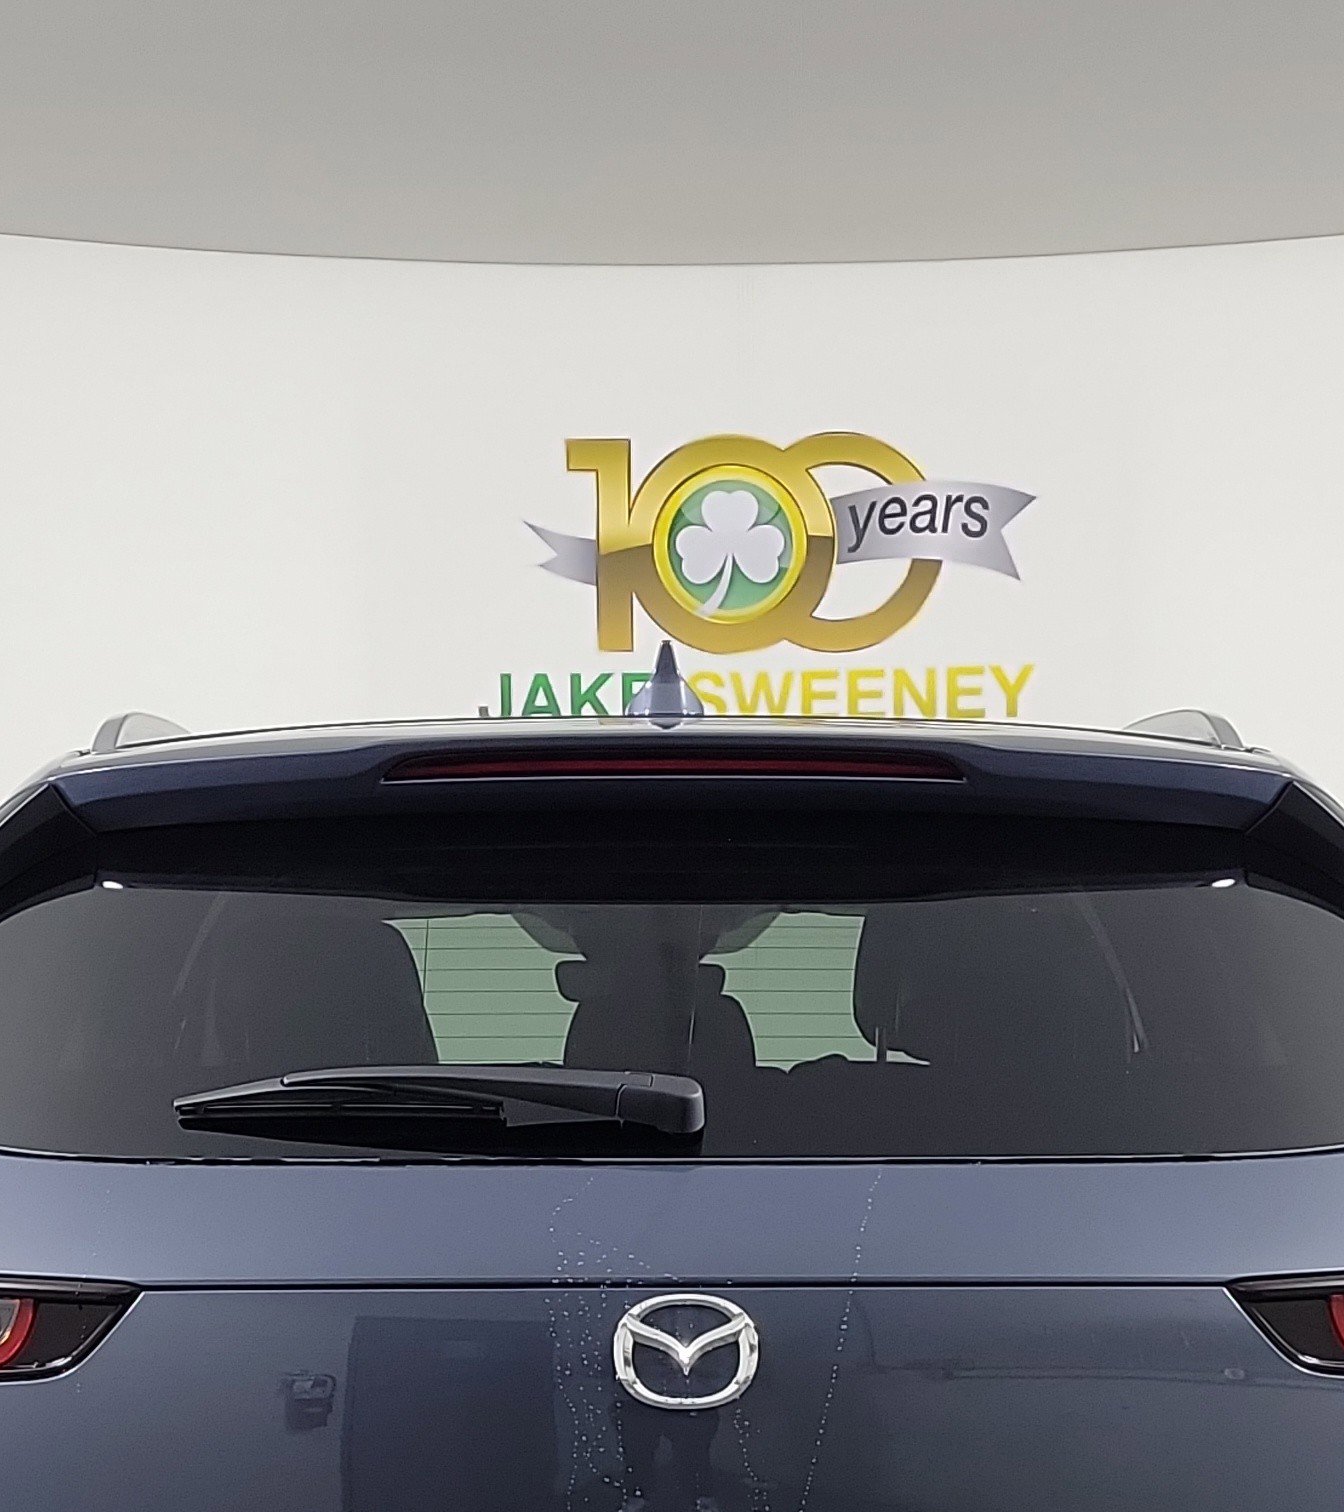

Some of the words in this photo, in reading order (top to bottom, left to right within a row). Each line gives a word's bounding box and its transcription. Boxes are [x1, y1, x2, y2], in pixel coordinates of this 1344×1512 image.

[565, 431, 943, 655] 100
[846, 492, 991, 553] years
[689, 663, 1036, 719] SWEENEY
